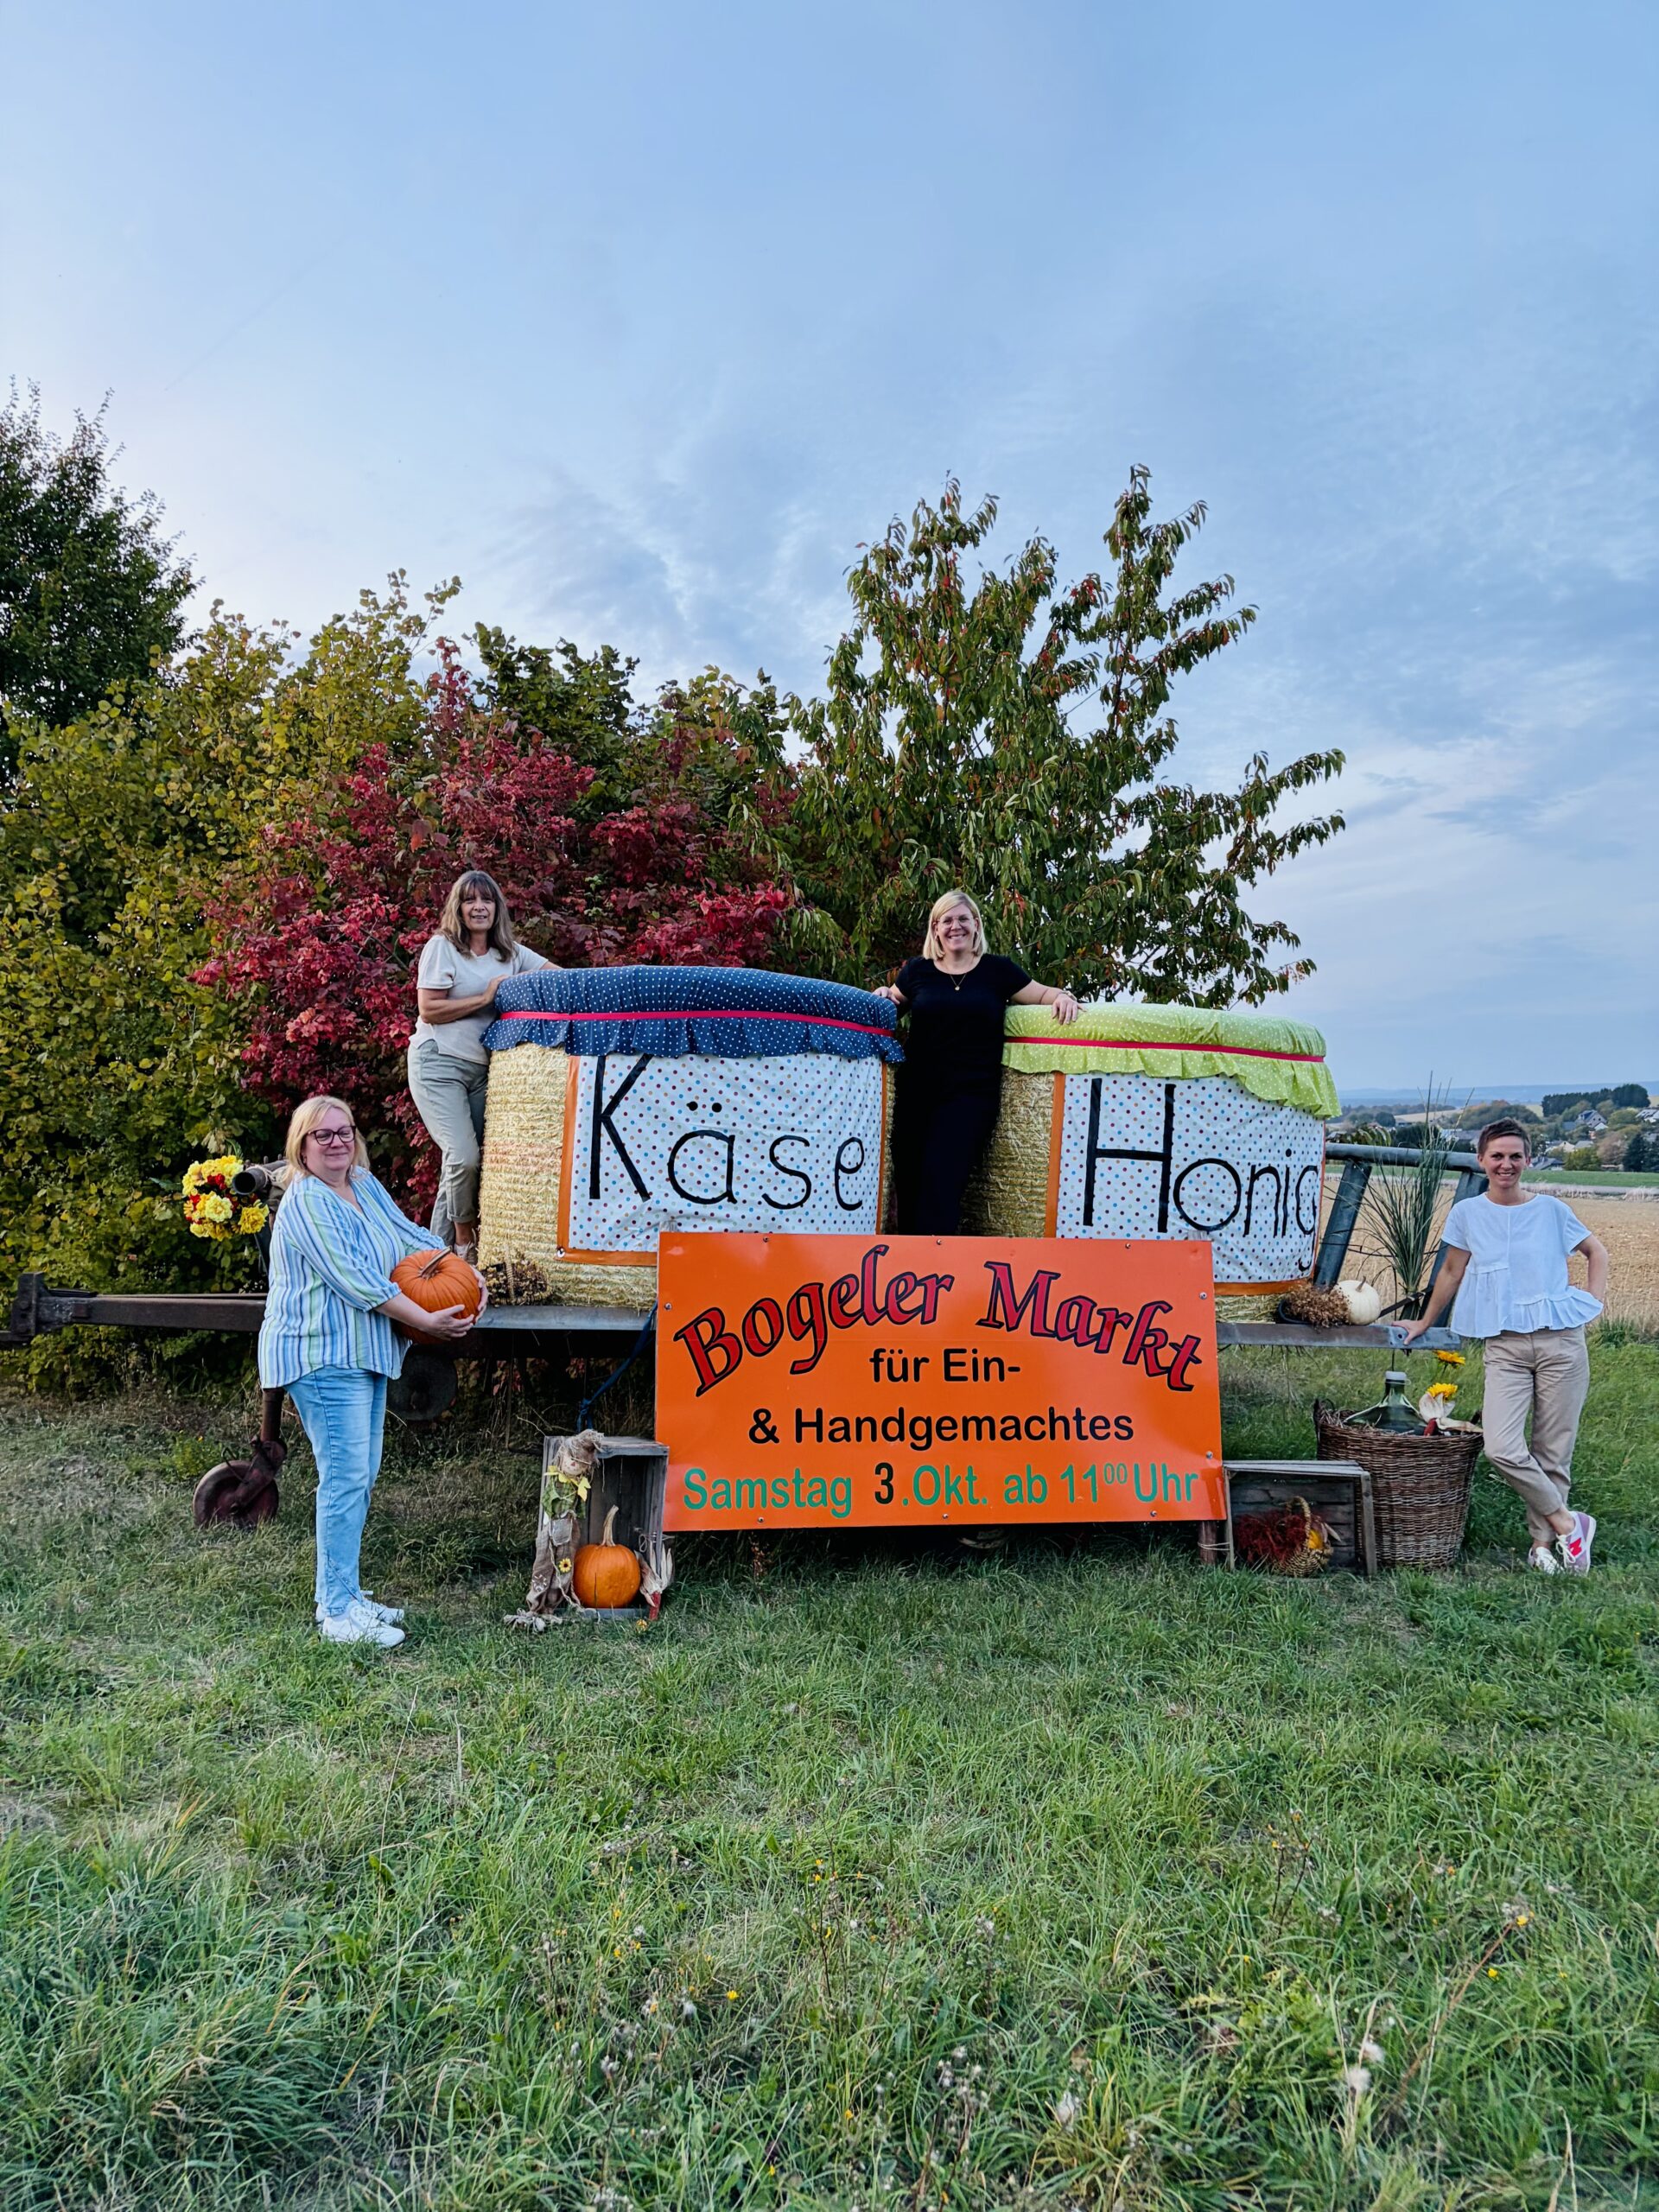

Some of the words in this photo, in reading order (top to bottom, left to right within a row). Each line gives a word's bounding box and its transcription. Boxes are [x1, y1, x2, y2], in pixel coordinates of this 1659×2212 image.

[588, 1053, 867, 1211] Käse
[1083, 1077, 1319, 1272] Honig
[672, 1244, 955, 1397] Bogeler
[975, 1261, 1203, 1392] Markt
[869, 1347, 930, 1382] für
[943, 1348, 1022, 1382] Ein-
[748, 1408, 780, 1445] &
[794, 1406, 1135, 1452] Handgemachtes
[683, 1467, 852, 1519] Samstag
[1003, 1464, 1048, 1505] ab
[1133, 1462, 1199, 1503] Uhr
